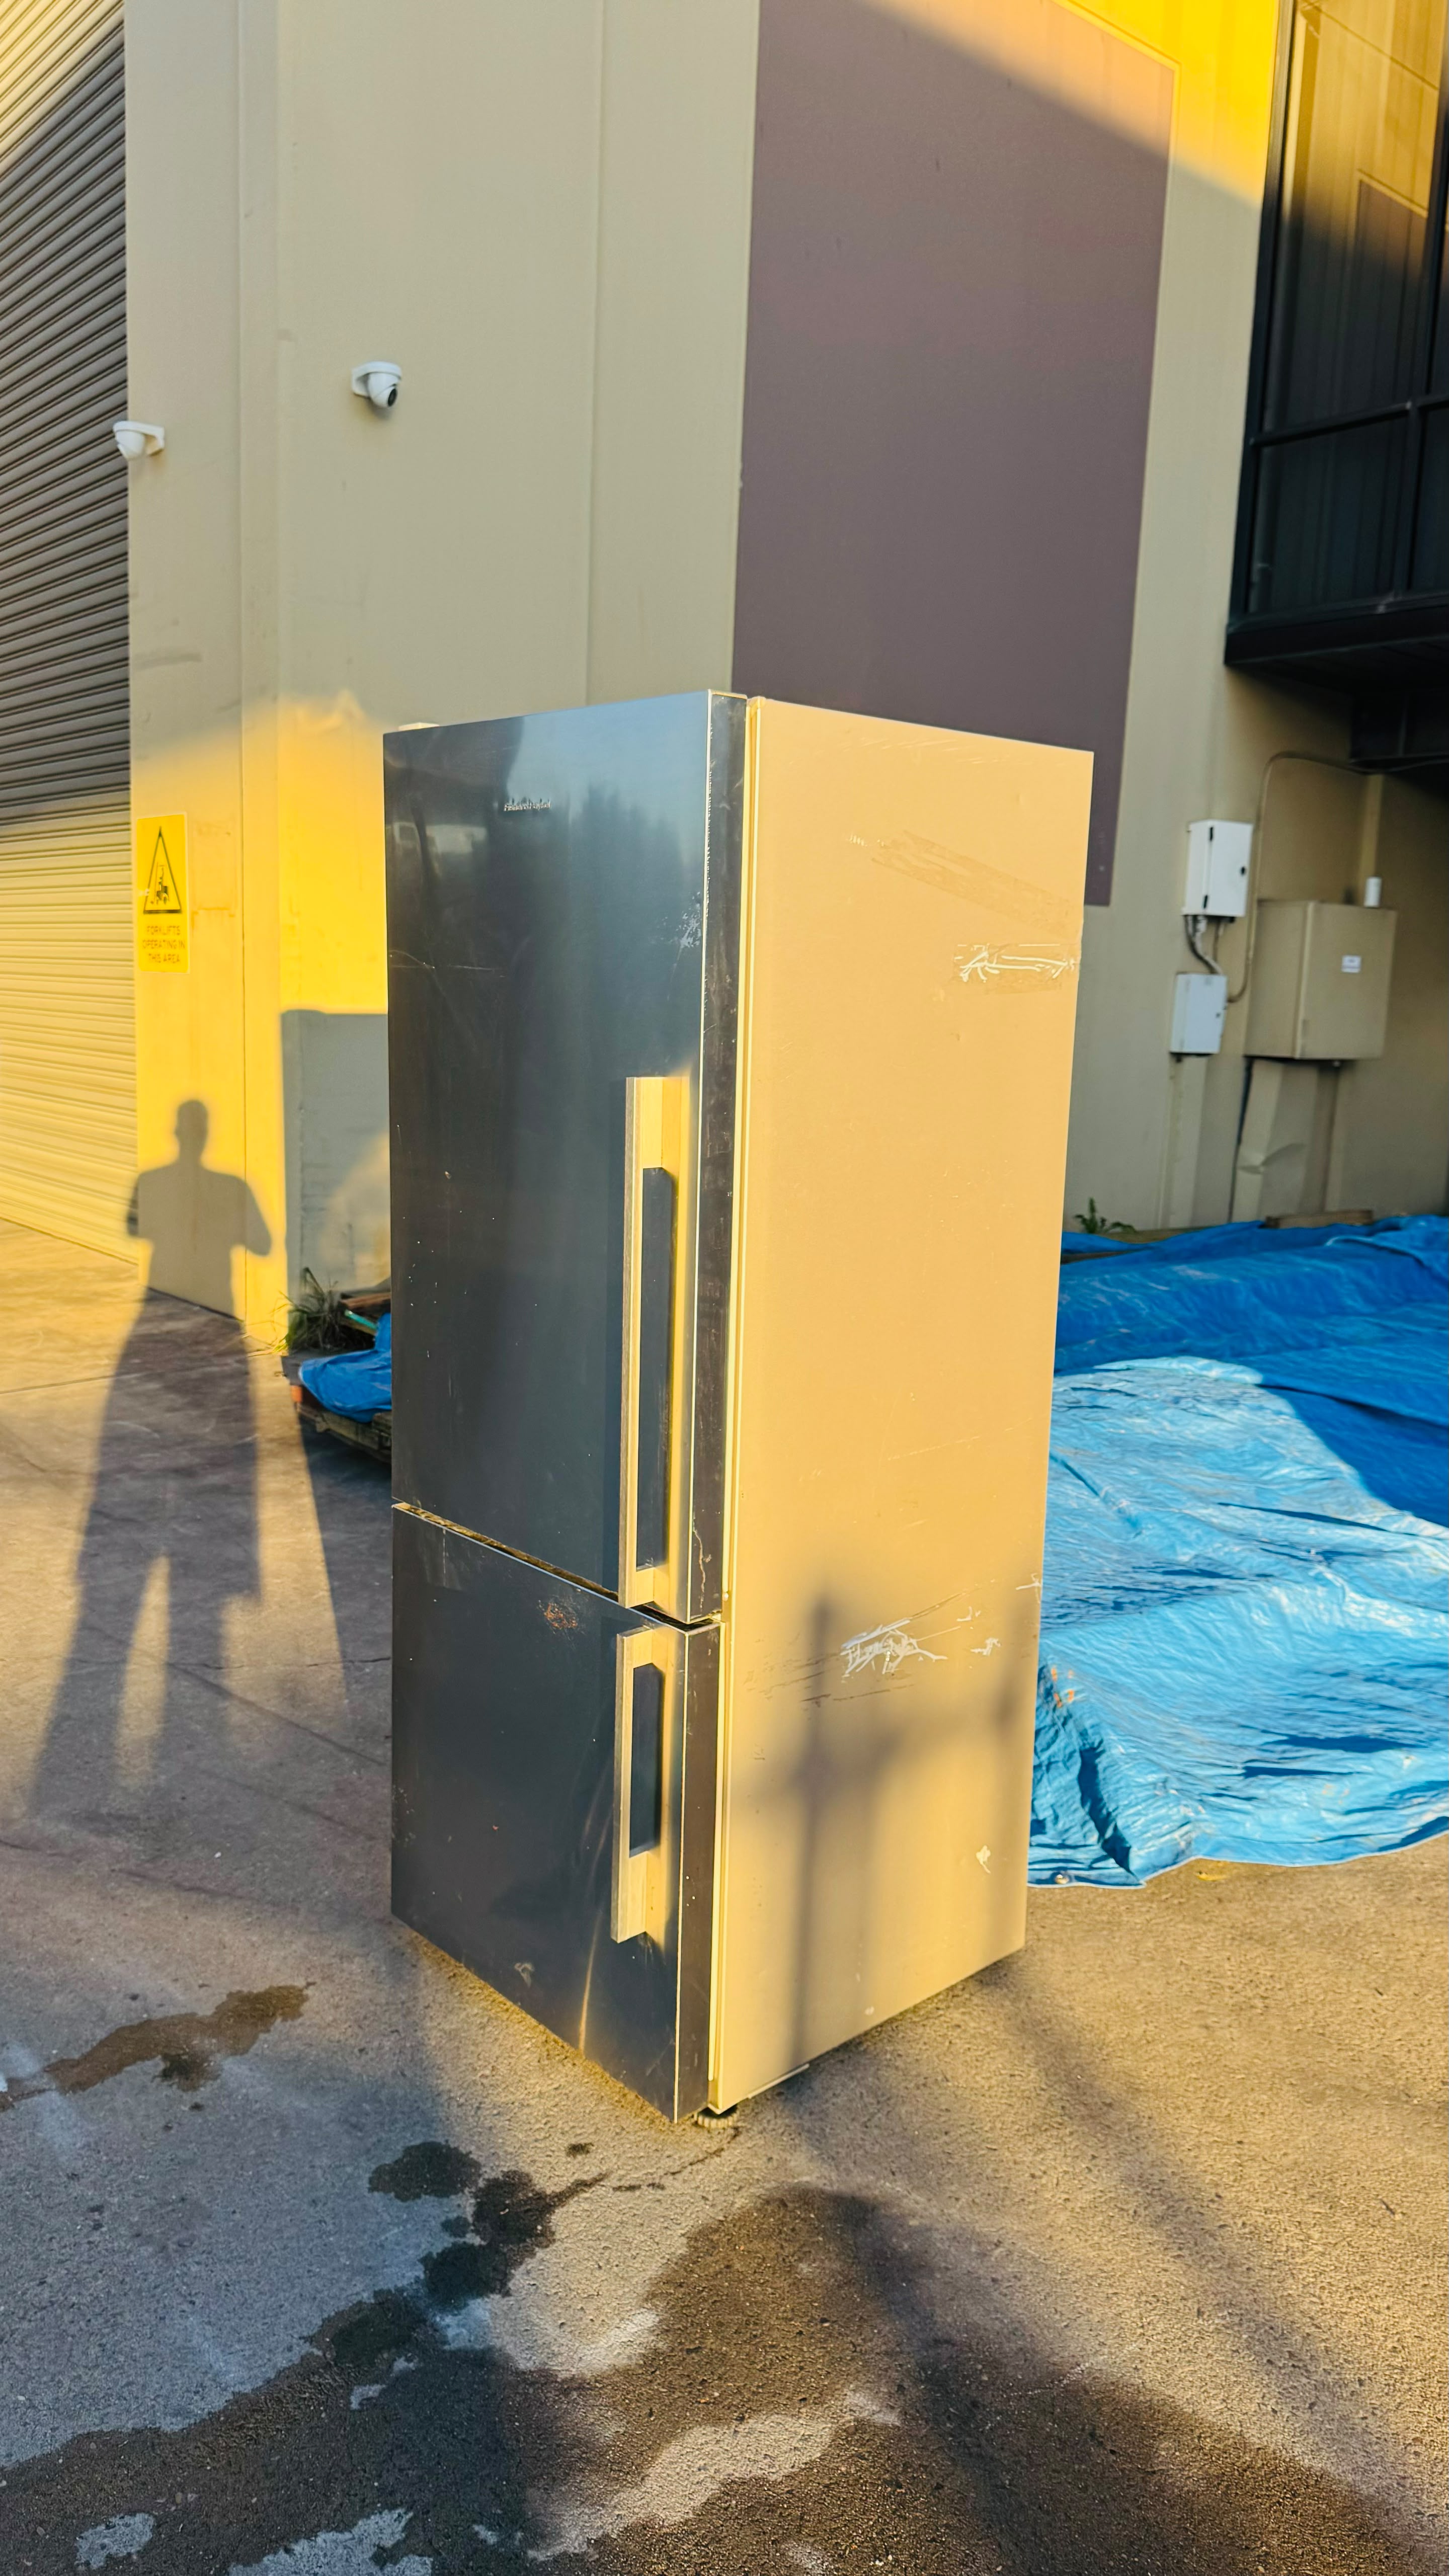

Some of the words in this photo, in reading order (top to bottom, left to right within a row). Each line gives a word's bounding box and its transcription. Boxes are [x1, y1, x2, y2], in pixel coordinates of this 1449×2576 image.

[146, 926, 180, 935] FORKLIFTS
[142, 939, 177, 949] OPERATING
[178, 939, 185, 949] IN
[163, 953, 181, 963] AREA
